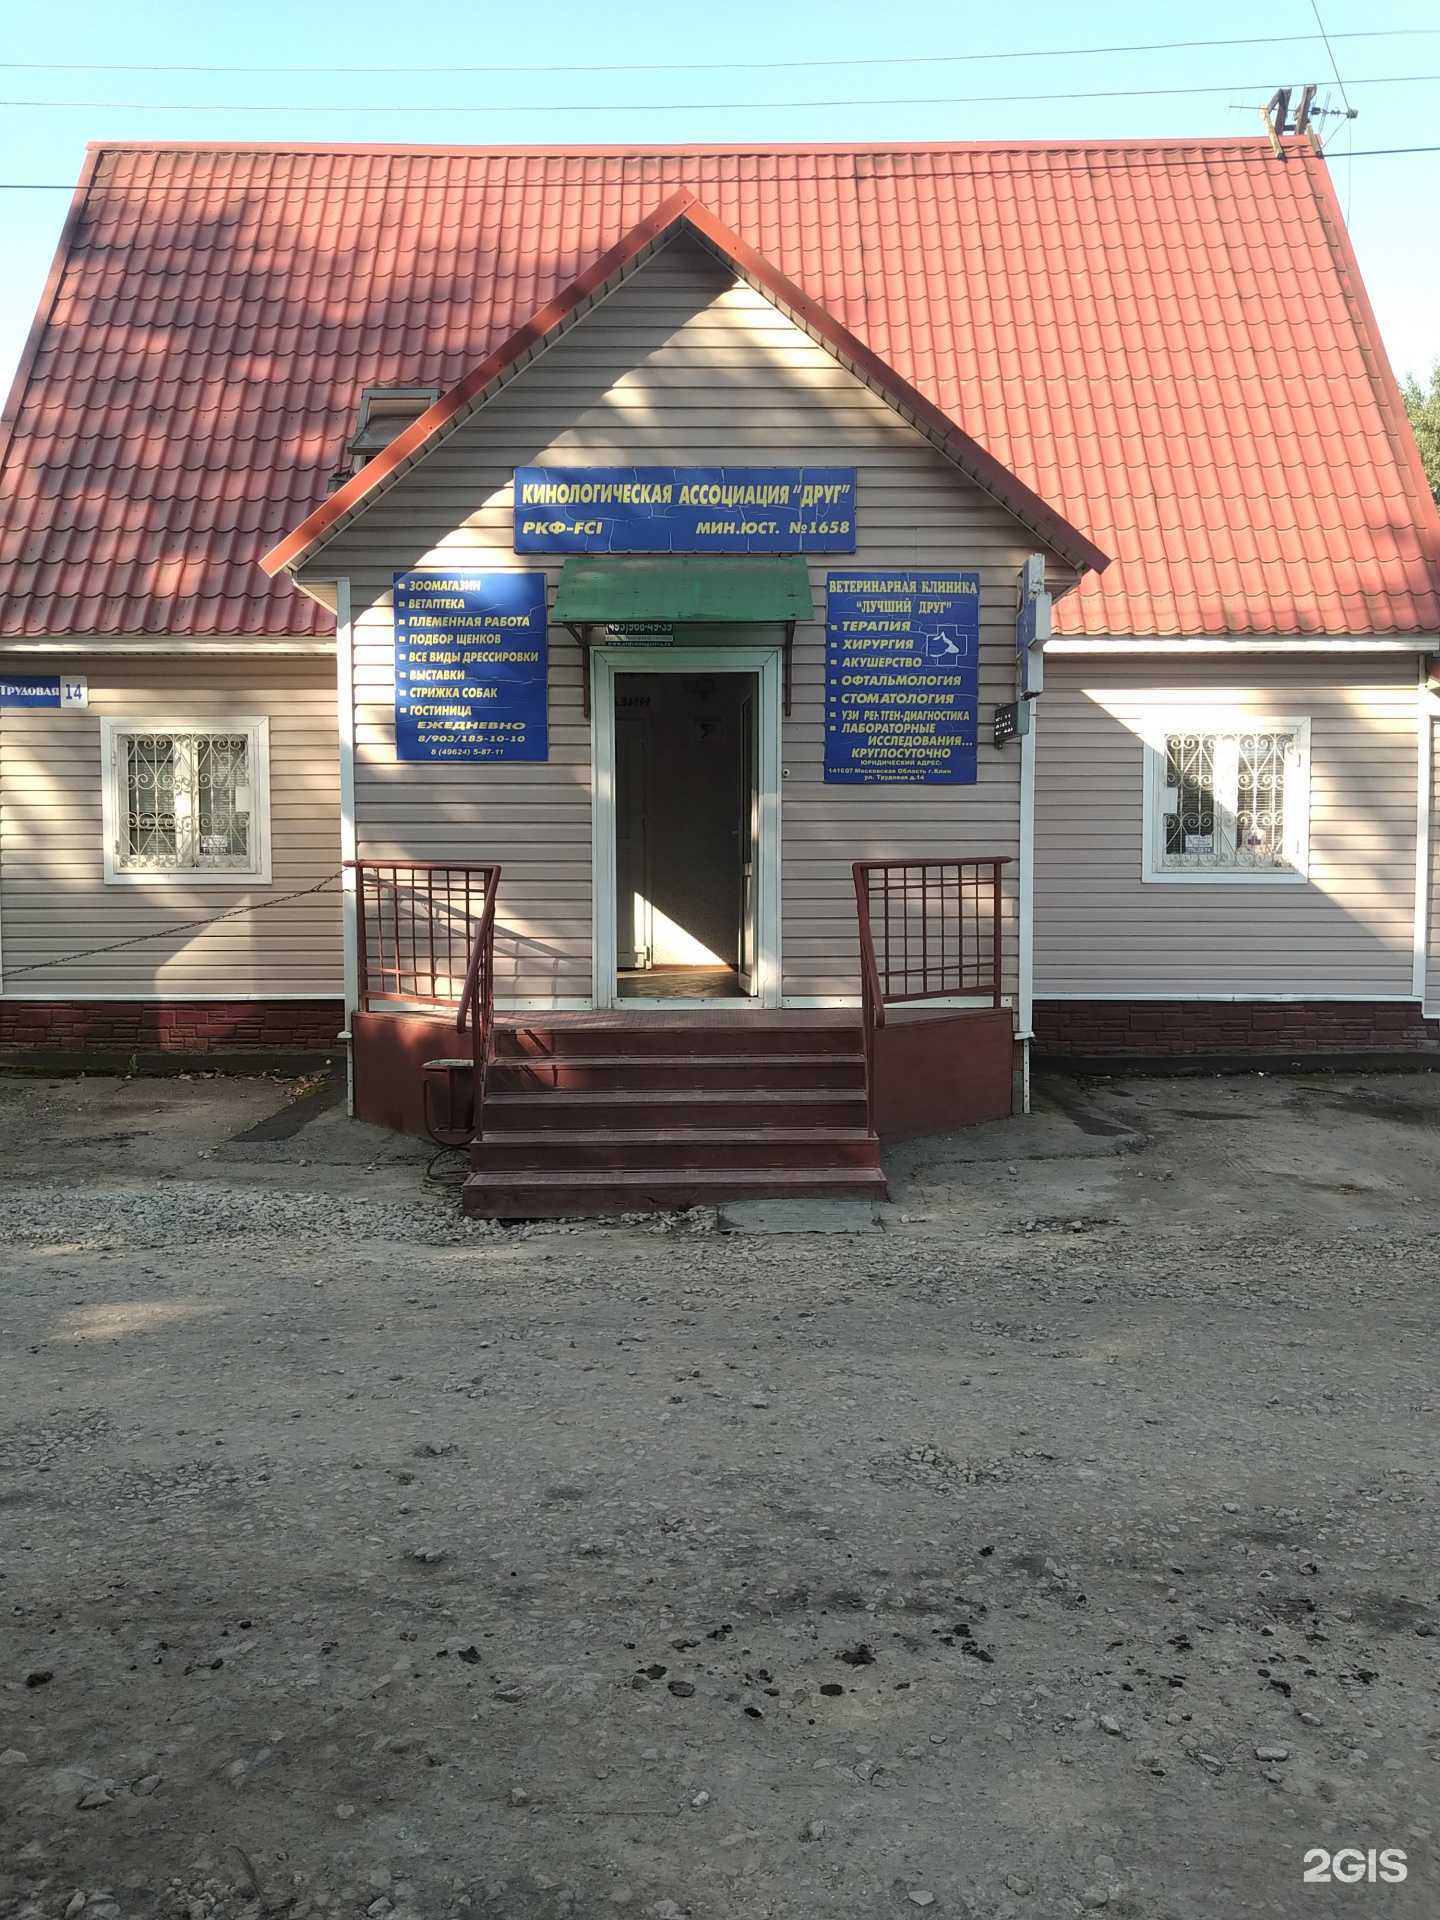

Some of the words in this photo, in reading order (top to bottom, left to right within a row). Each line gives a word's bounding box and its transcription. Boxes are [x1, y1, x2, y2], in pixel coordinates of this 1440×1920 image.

[522, 484, 672, 505] КИНОЛОГИЧЕСКАЯ
[679, 485, 789, 508] АССОЦИАЦИЯ
[522, 521, 603, 535] РКФ-FCI
[696, 521, 780, 535] МИН.ЮСТ.
[409, 580, 481, 591] ЗООМАГАЗИН
[829, 580, 917, 593] ВЕТЕРИНАРНАЯ
[922, 581, 977, 594] КЛИНИКА
[408, 599, 465, 609] ВЕТАПТЕКА
[408, 616, 482, 627] ПЛЕМЕННАЯ
[484, 616, 530, 627] РАБОТА
[842, 621, 912, 632] ТЕРАПИЯ
[409, 634, 454, 646] ПОДБОР
[456, 634, 501, 645] ЩЕНКОВ
[842, 639, 914, 650] ХИРУРГИЯ
[408, 652, 427, 662] ВСЕ
[429, 652, 460, 664] ВИДЫ
[463, 652, 539, 664] ДРЕССИРОВКИ
[842, 658, 922, 668] АКУШЕРСТВО
[409, 670, 465, 681] ВЫСТАВКИ
[841, 676, 962, 686] ОФТАЛЬМОЛОГИЯ
[65, 683, 82, 700] 14
[409, 687, 460, 698] СТРИЖКА
[462, 687, 498, 698] СОБАК
[841, 694, 955, 704] СТОМАТОЛОГИЯ
[409, 705, 472, 717] ГОСТИНИЦА
[841, 711, 859, 721] УЗИ
[417, 721, 527, 731] ЕЖЕДНЕВНО
[841, 723, 937, 733] ЛАБОРАТОРНЫЕ
[851, 748, 952, 759] КРУГЛОСУТОЧНО
